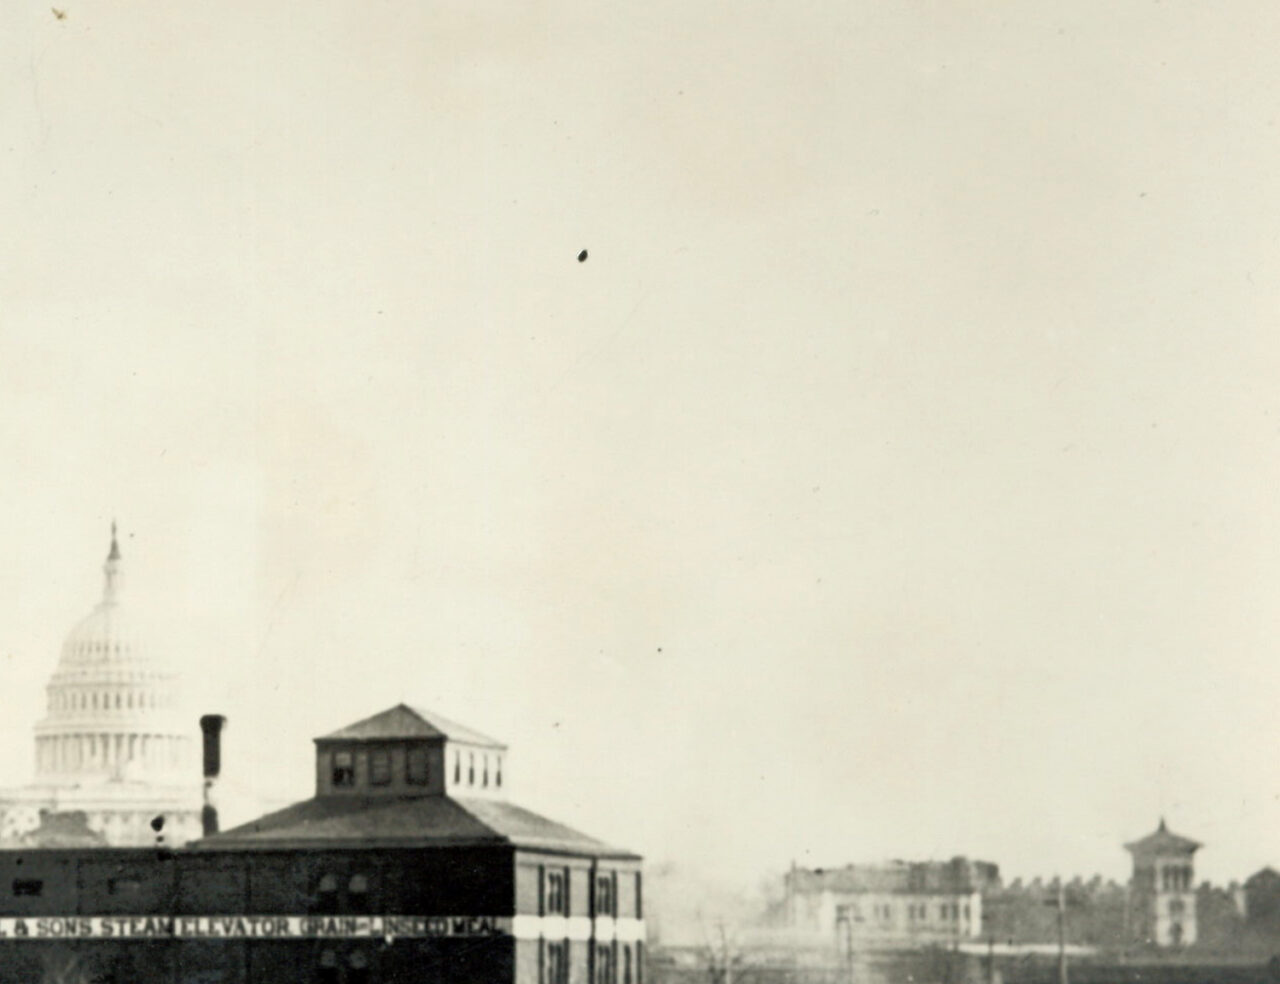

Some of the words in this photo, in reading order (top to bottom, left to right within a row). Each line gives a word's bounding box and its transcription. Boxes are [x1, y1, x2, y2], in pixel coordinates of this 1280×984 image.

[15, 918, 29, 938] &
[36, 918, 92, 938] SONS
[100, 918, 172, 938] STEAM
[180, 918, 289, 938] ELEVATOR
